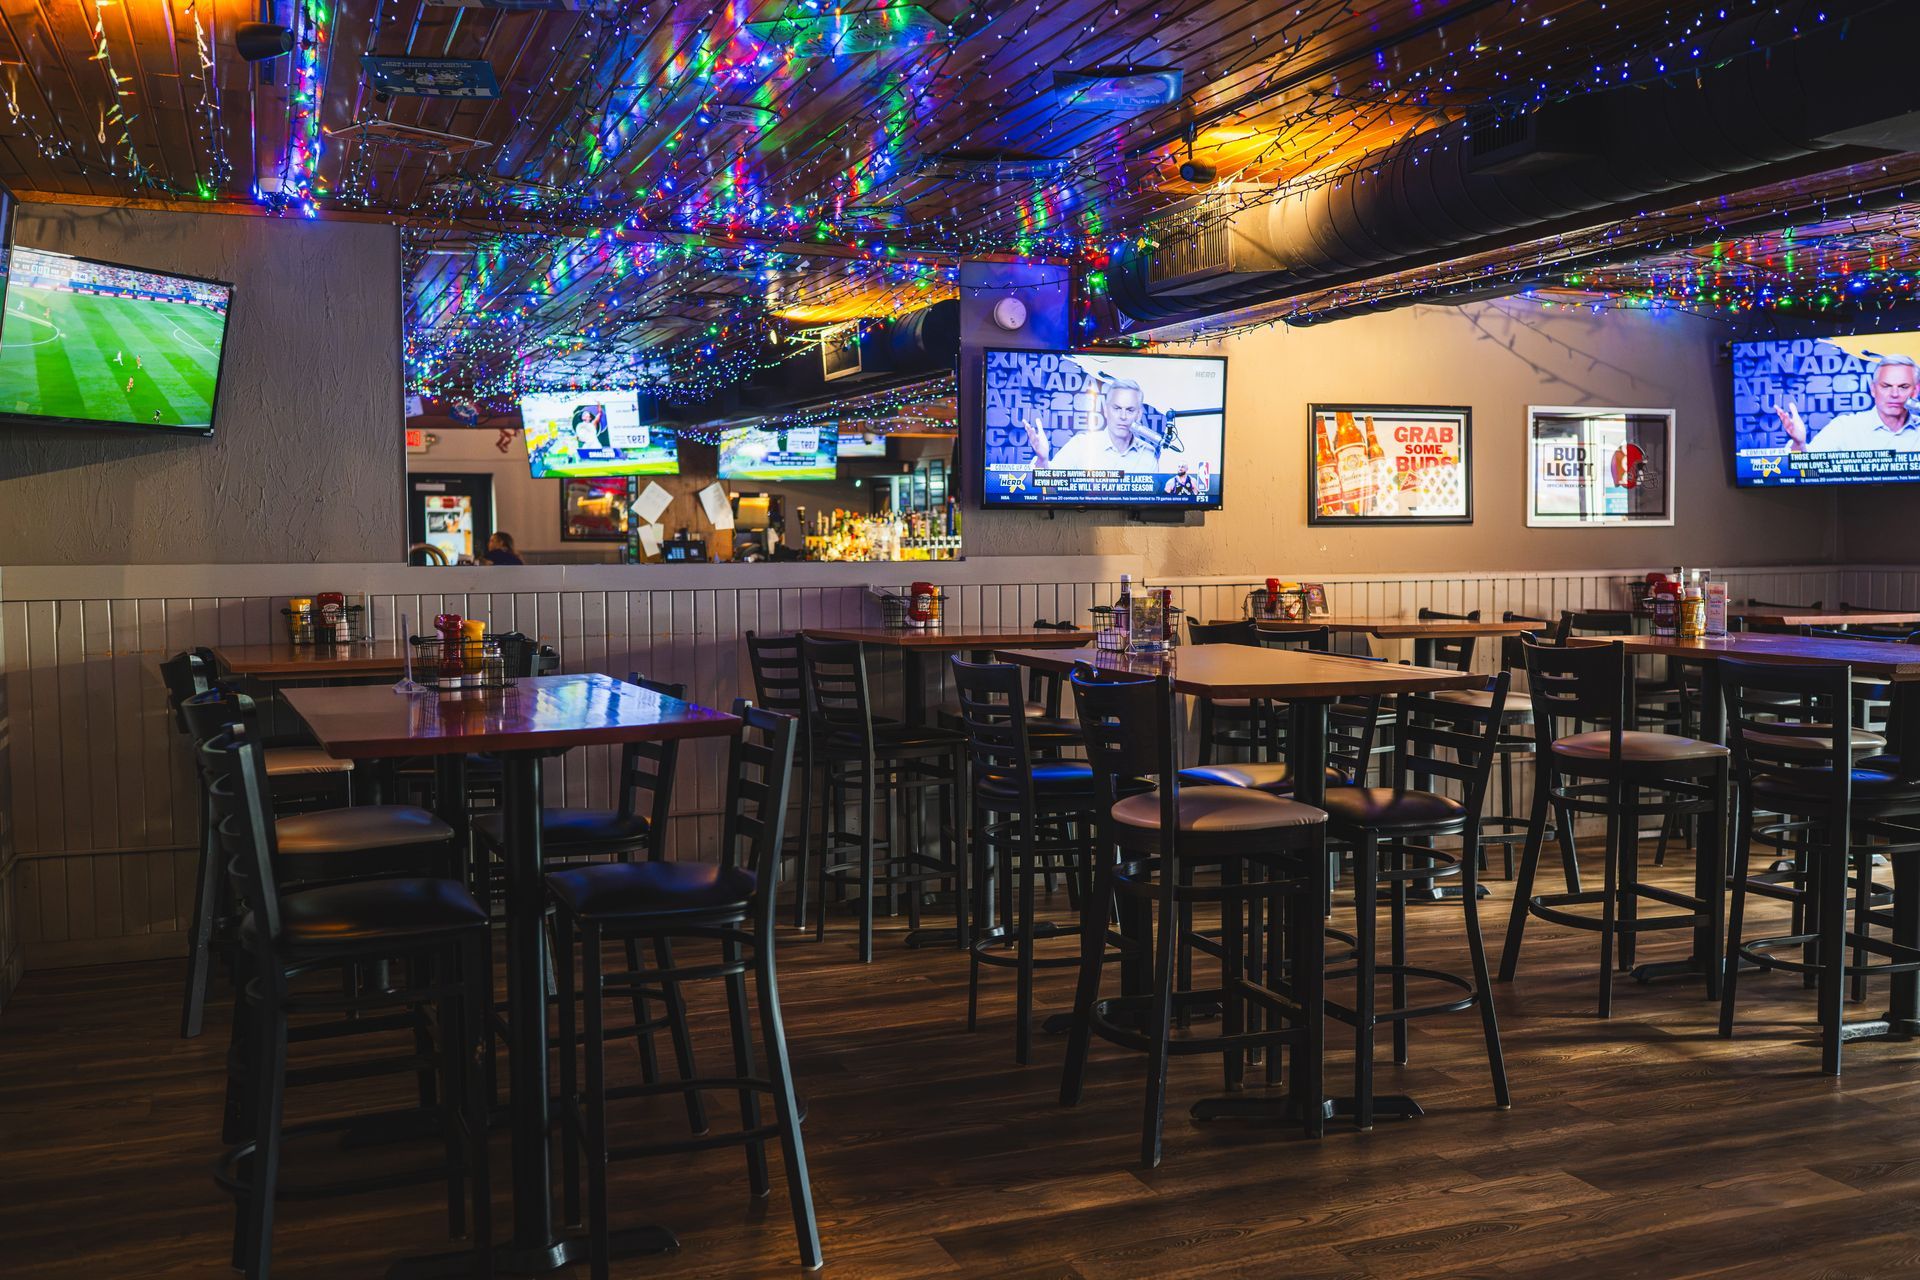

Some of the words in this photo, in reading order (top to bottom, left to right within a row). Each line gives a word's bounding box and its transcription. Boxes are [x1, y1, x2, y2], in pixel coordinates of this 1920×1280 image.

[1394, 426, 1454, 443] GRAB
[1405, 444, 1443, 455] SOME
[1553, 447, 1586, 461] BUD
[1851, 451, 1855, 459] A
[1874, 450, 1891, 458] TIME.
[1895, 453, 1908, 462] THE
[1546, 462, 1594, 477] LIGHT
[1809, 461, 1830, 469] LOVE'S
[1843, 464, 1860, 472] WILL
[1861, 463, 1871, 472] HE
[1872, 463, 1889, 471] PLAY
[1890, 462, 1909, 471] NEXT
[1091, 470, 1106, 478] GOOD
[1078, 483, 1092, 491] WILL
[1092, 483, 1100, 491] HE
[1101, 483, 1115, 491] PLAY
[1116, 483, 1130, 491] NEXT
[1131, 483, 1154, 491] SEASON
